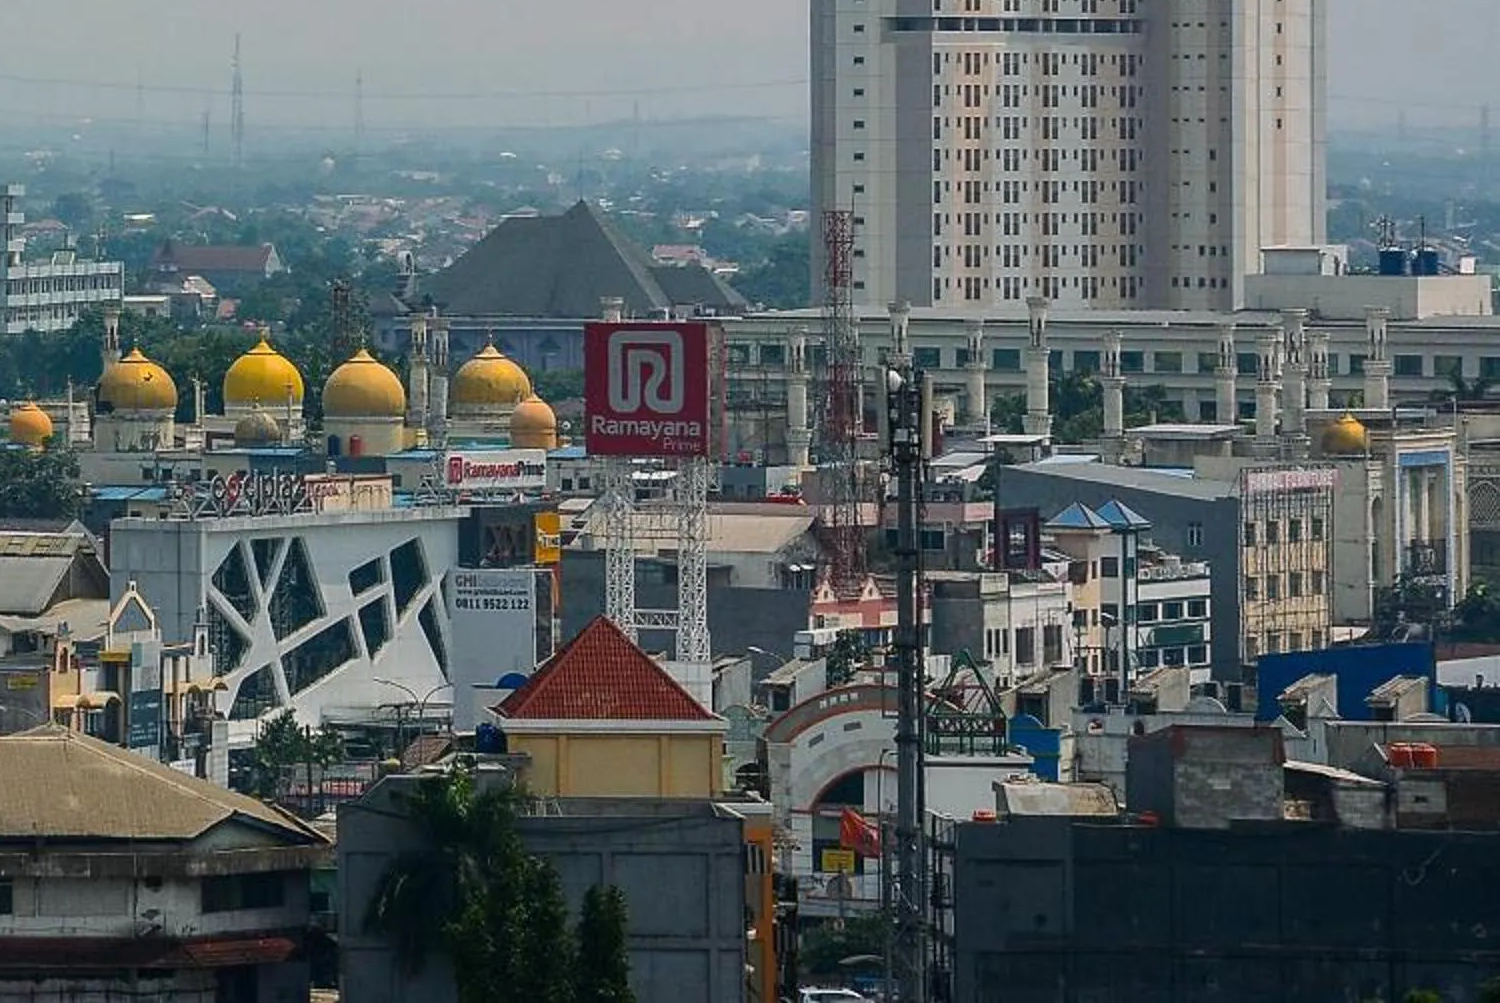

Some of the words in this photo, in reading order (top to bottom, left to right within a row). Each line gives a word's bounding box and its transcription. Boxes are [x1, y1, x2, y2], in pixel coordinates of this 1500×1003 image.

[591, 414, 700, 439] Ramayana
[663, 436, 701, 451] Prime
[511, 598, 529, 610] 122
